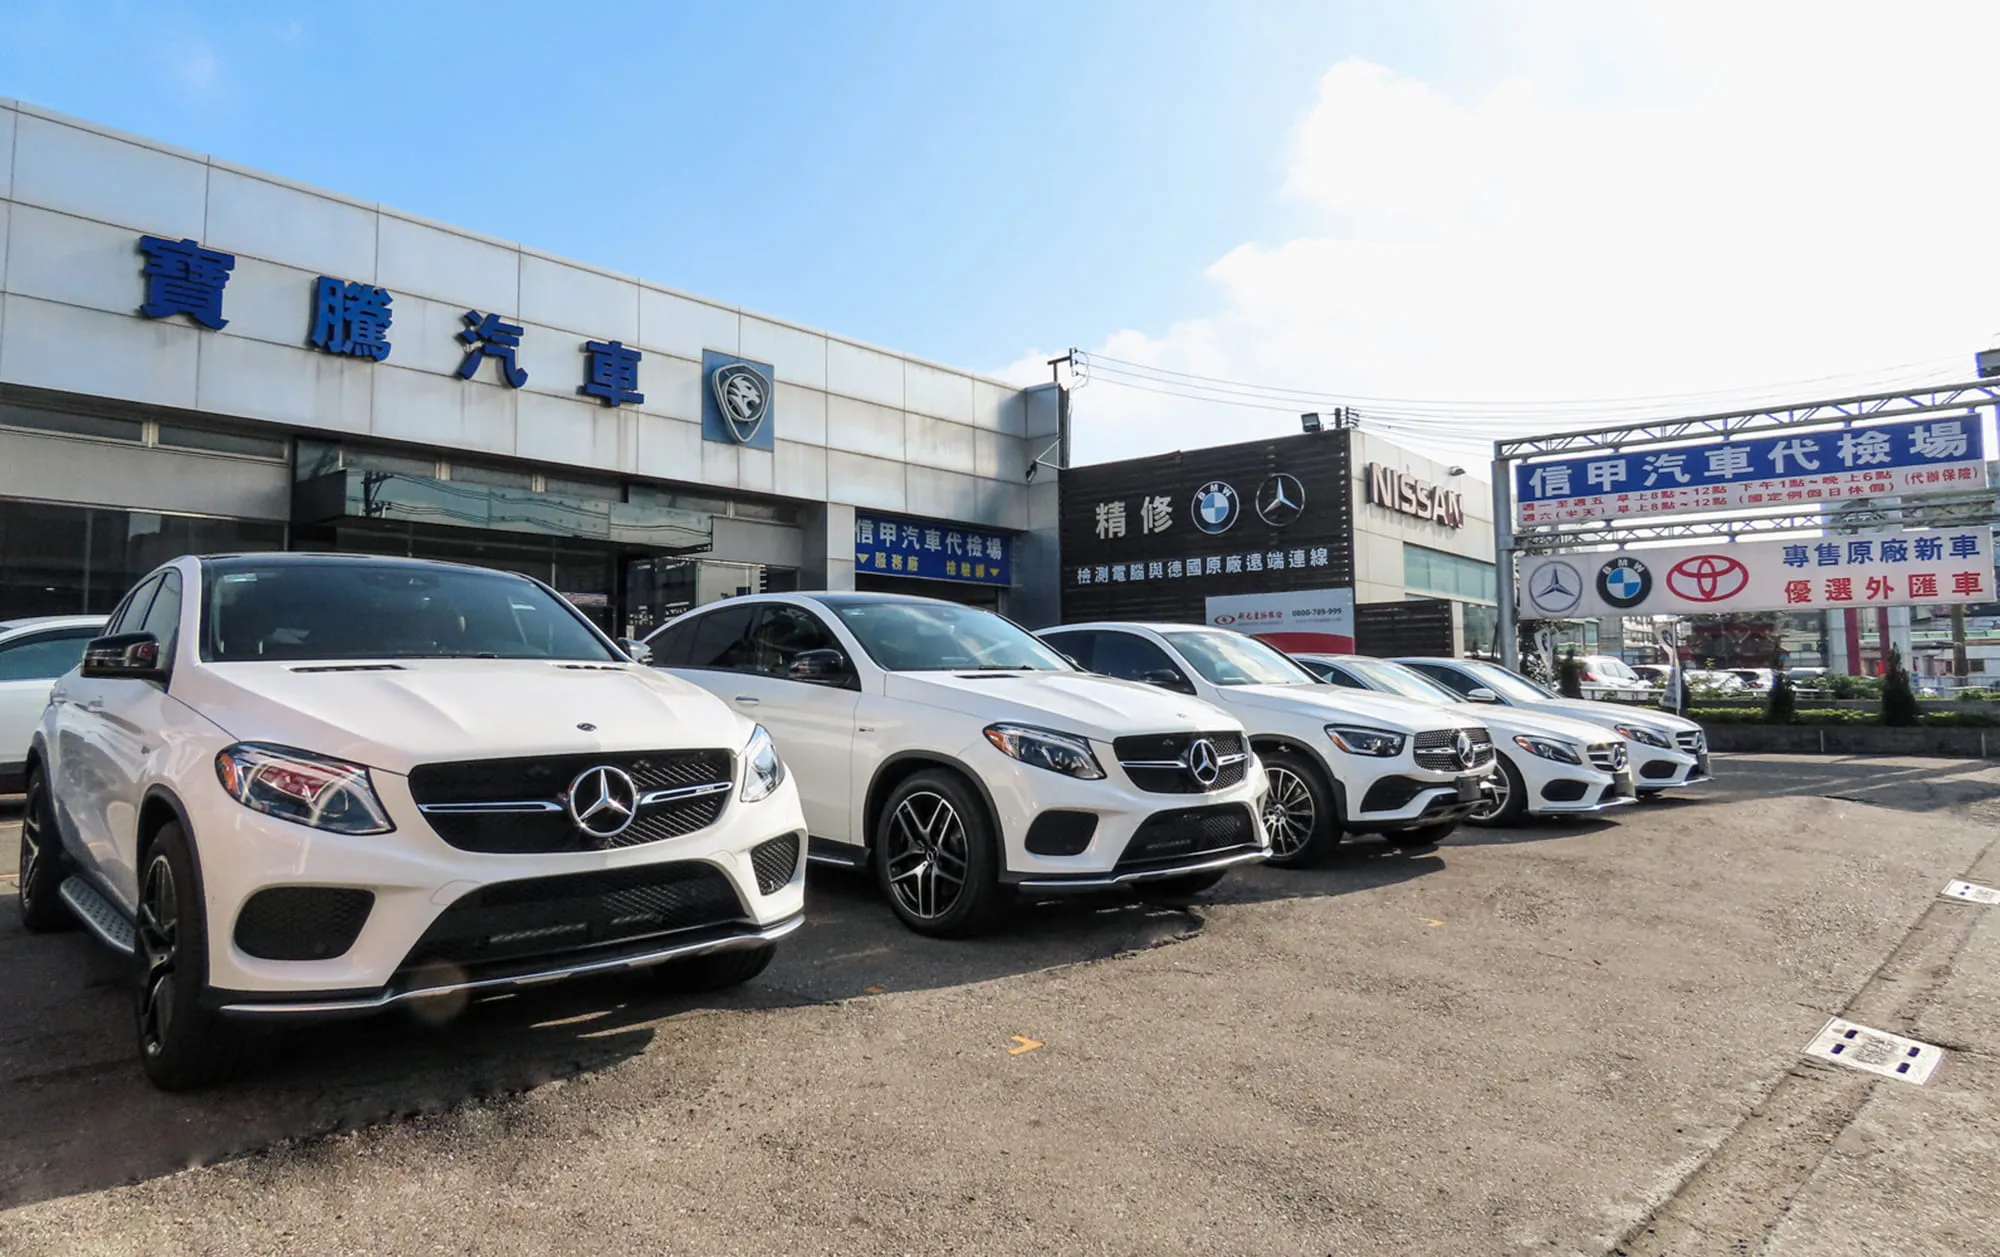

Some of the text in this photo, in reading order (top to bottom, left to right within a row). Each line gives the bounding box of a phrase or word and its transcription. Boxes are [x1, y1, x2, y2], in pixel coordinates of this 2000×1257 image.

[139, 234, 644, 407] 寶騰汽車
[1529, 421, 1968, 498] 信甲汽車代檢場
[1198, 484, 1233, 501] BMW
[1368, 462, 1464, 530] NISSAN
[1522, 497, 1604, 511] 週一至週五
[1095, 495, 1173, 540] 精修
[856, 519, 1002, 560] 信甲汽車代檢場
[1783, 534, 1981, 568] 專售原廠新車
[1077, 547, 1329, 585] 檢測電腦與德國原廠遠端連線
[1602, 557, 1645, 576] BMW
[1784, 570, 1984, 604] 優選外匯車
